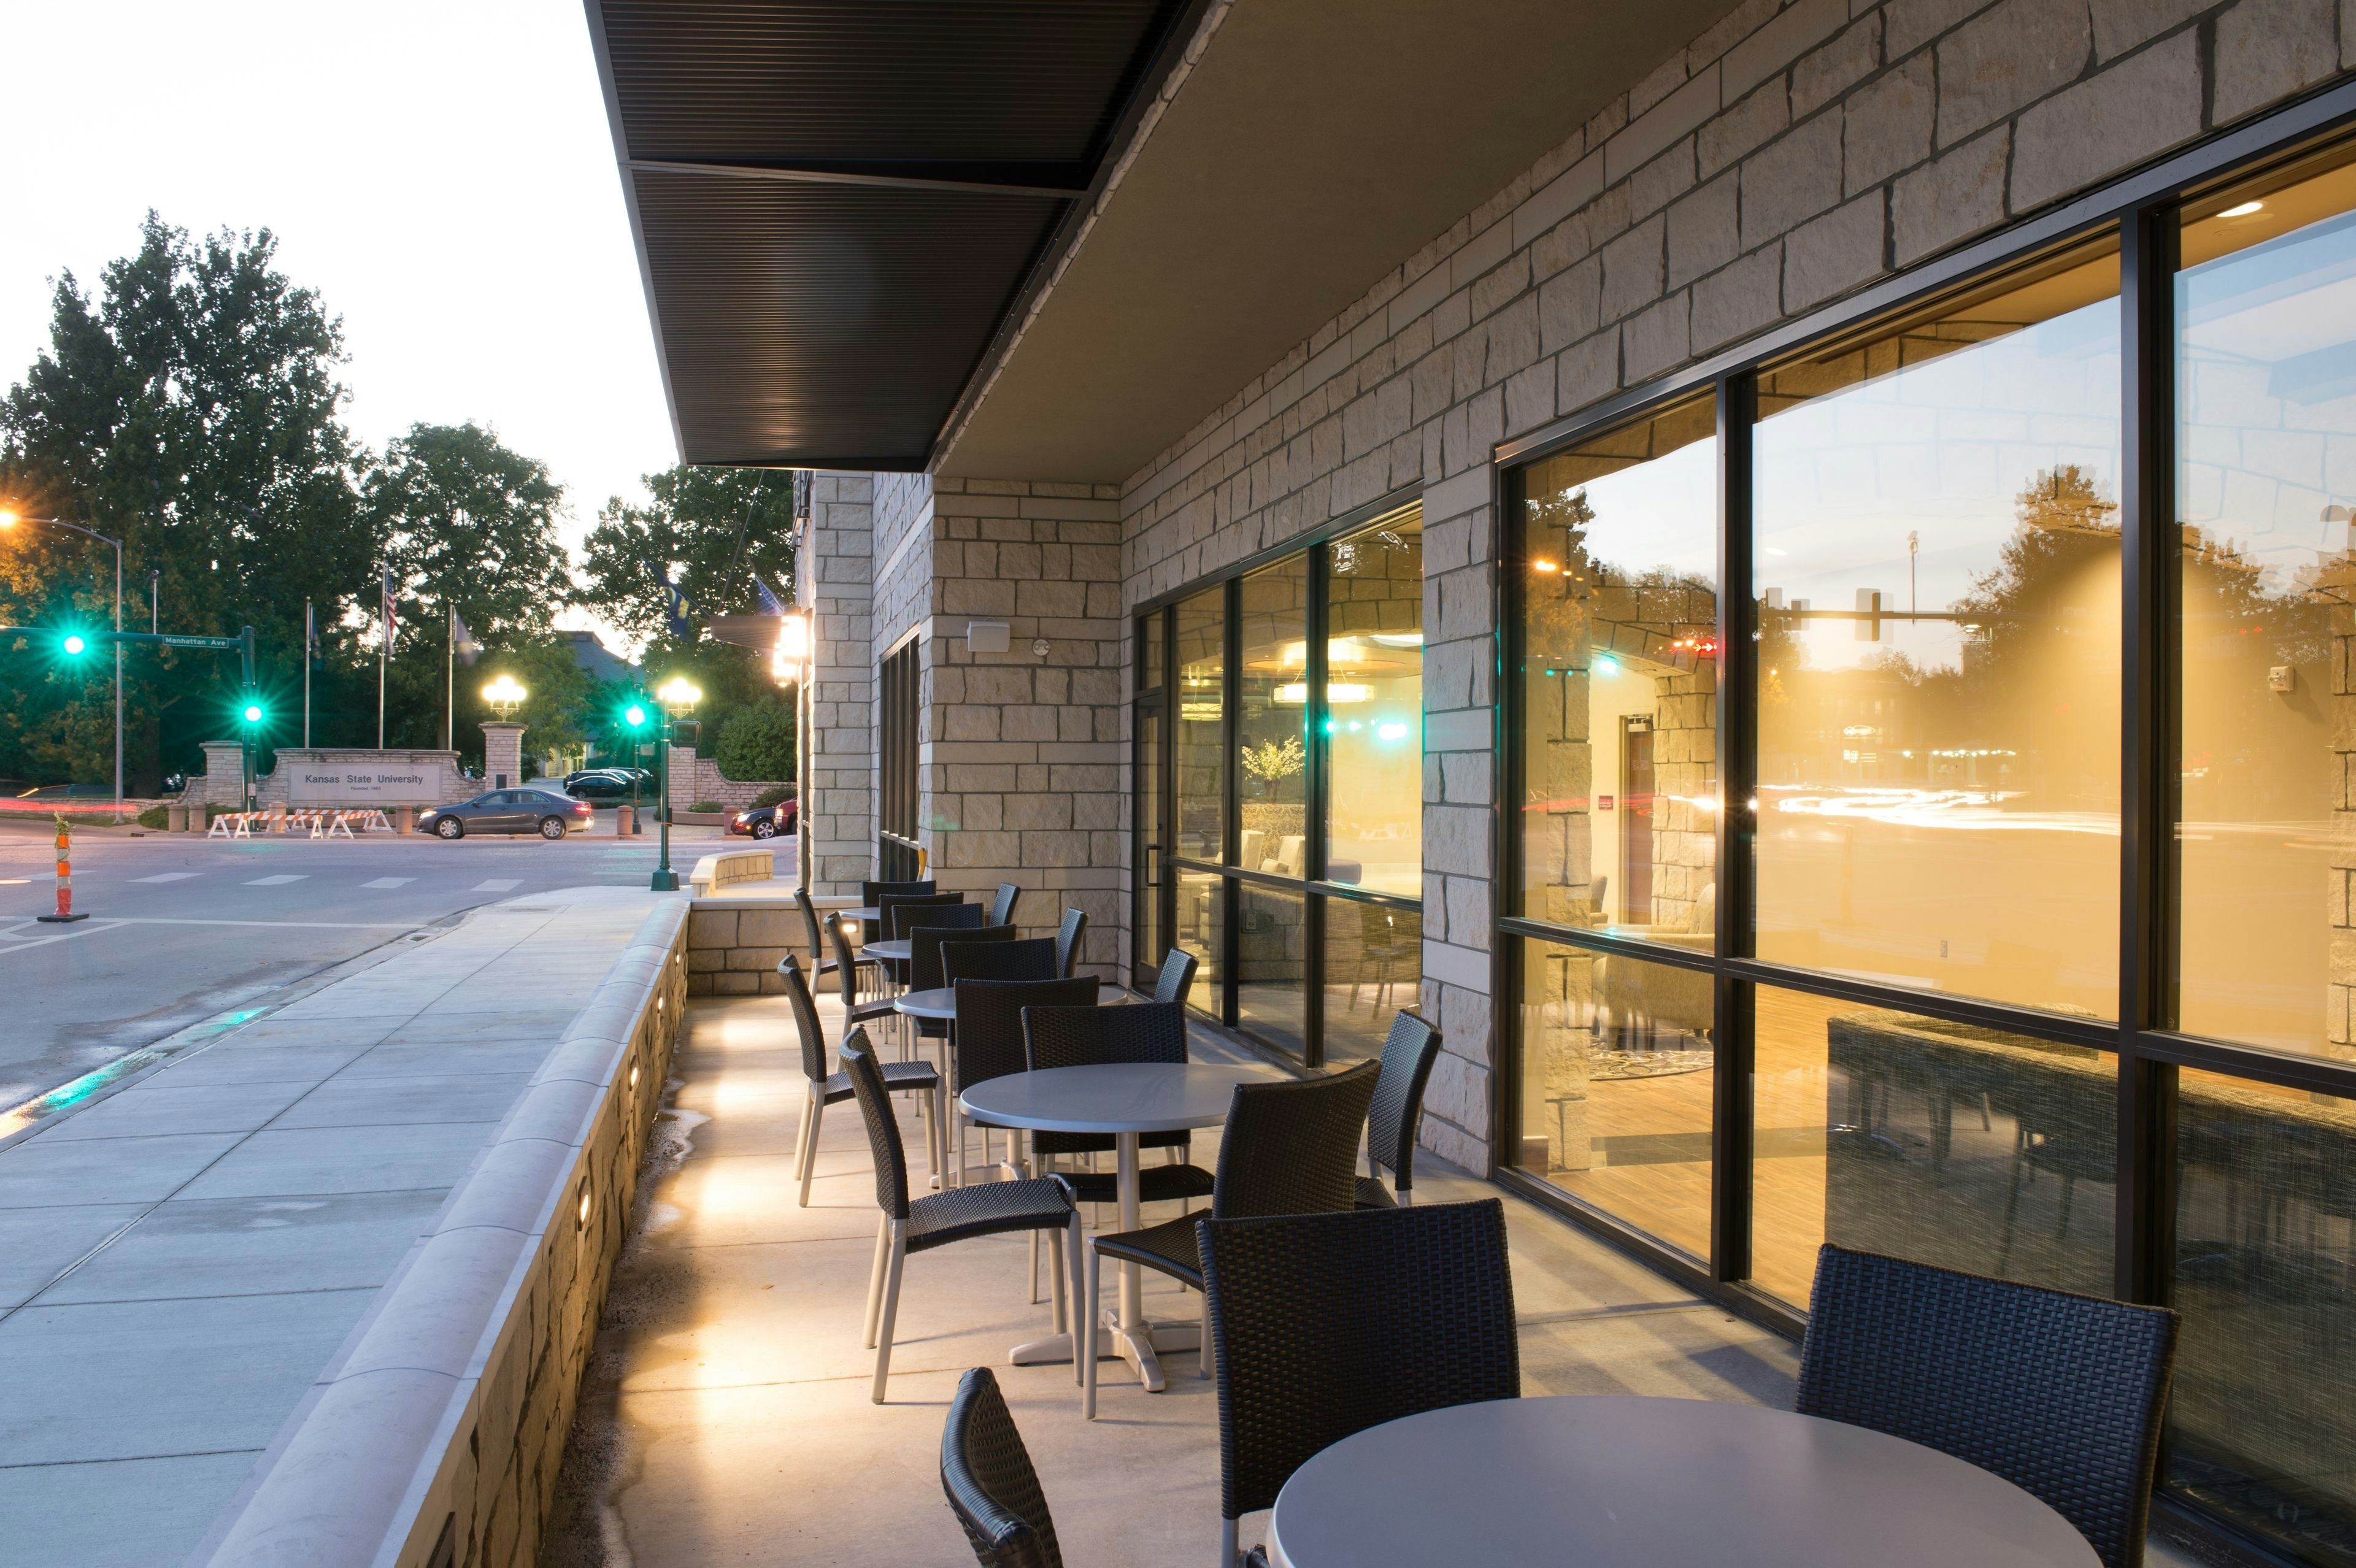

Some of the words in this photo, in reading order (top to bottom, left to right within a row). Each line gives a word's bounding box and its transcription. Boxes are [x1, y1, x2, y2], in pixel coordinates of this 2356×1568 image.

[165, 637, 206, 645] Manhattan
[305, 775, 340, 783] Kansas
[347, 775, 372, 783] State
[377, 775, 423, 785] University
